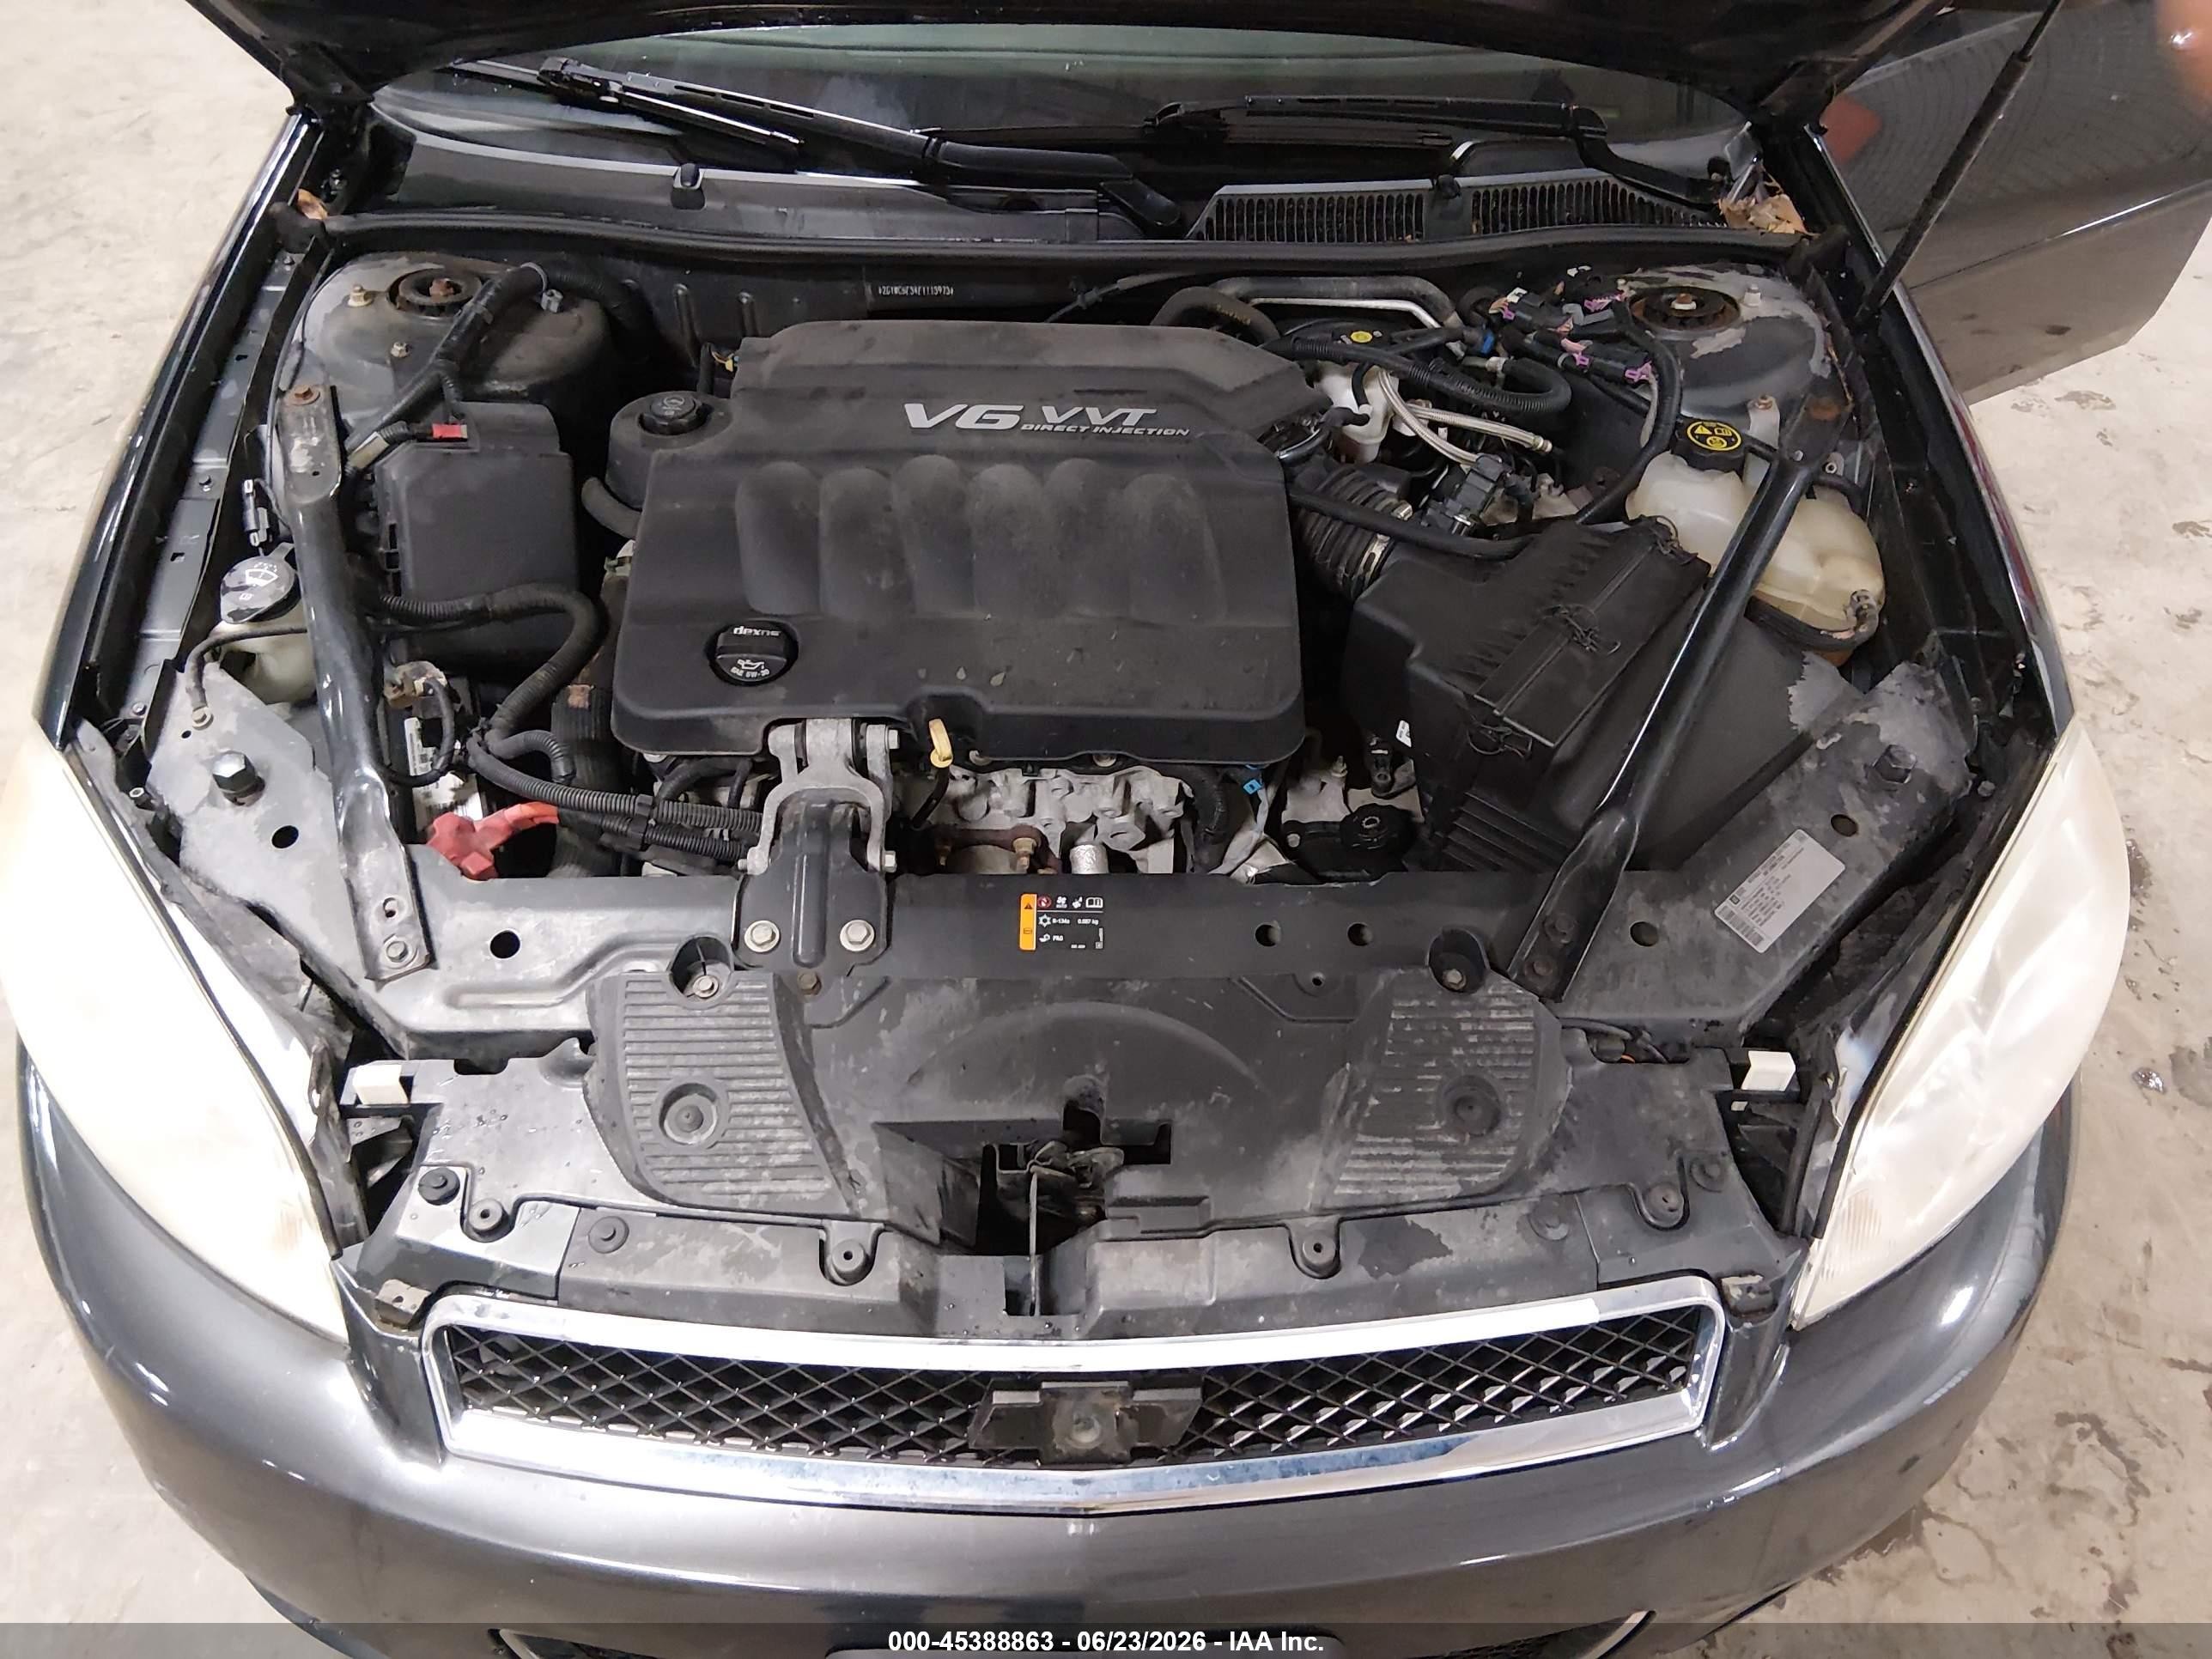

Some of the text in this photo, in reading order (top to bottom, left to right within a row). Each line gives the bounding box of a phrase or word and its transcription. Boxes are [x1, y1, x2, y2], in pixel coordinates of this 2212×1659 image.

[904, 404, 1158, 429] V6 VVT
[1020, 423, 1190, 436] DIRECT INJECTION
